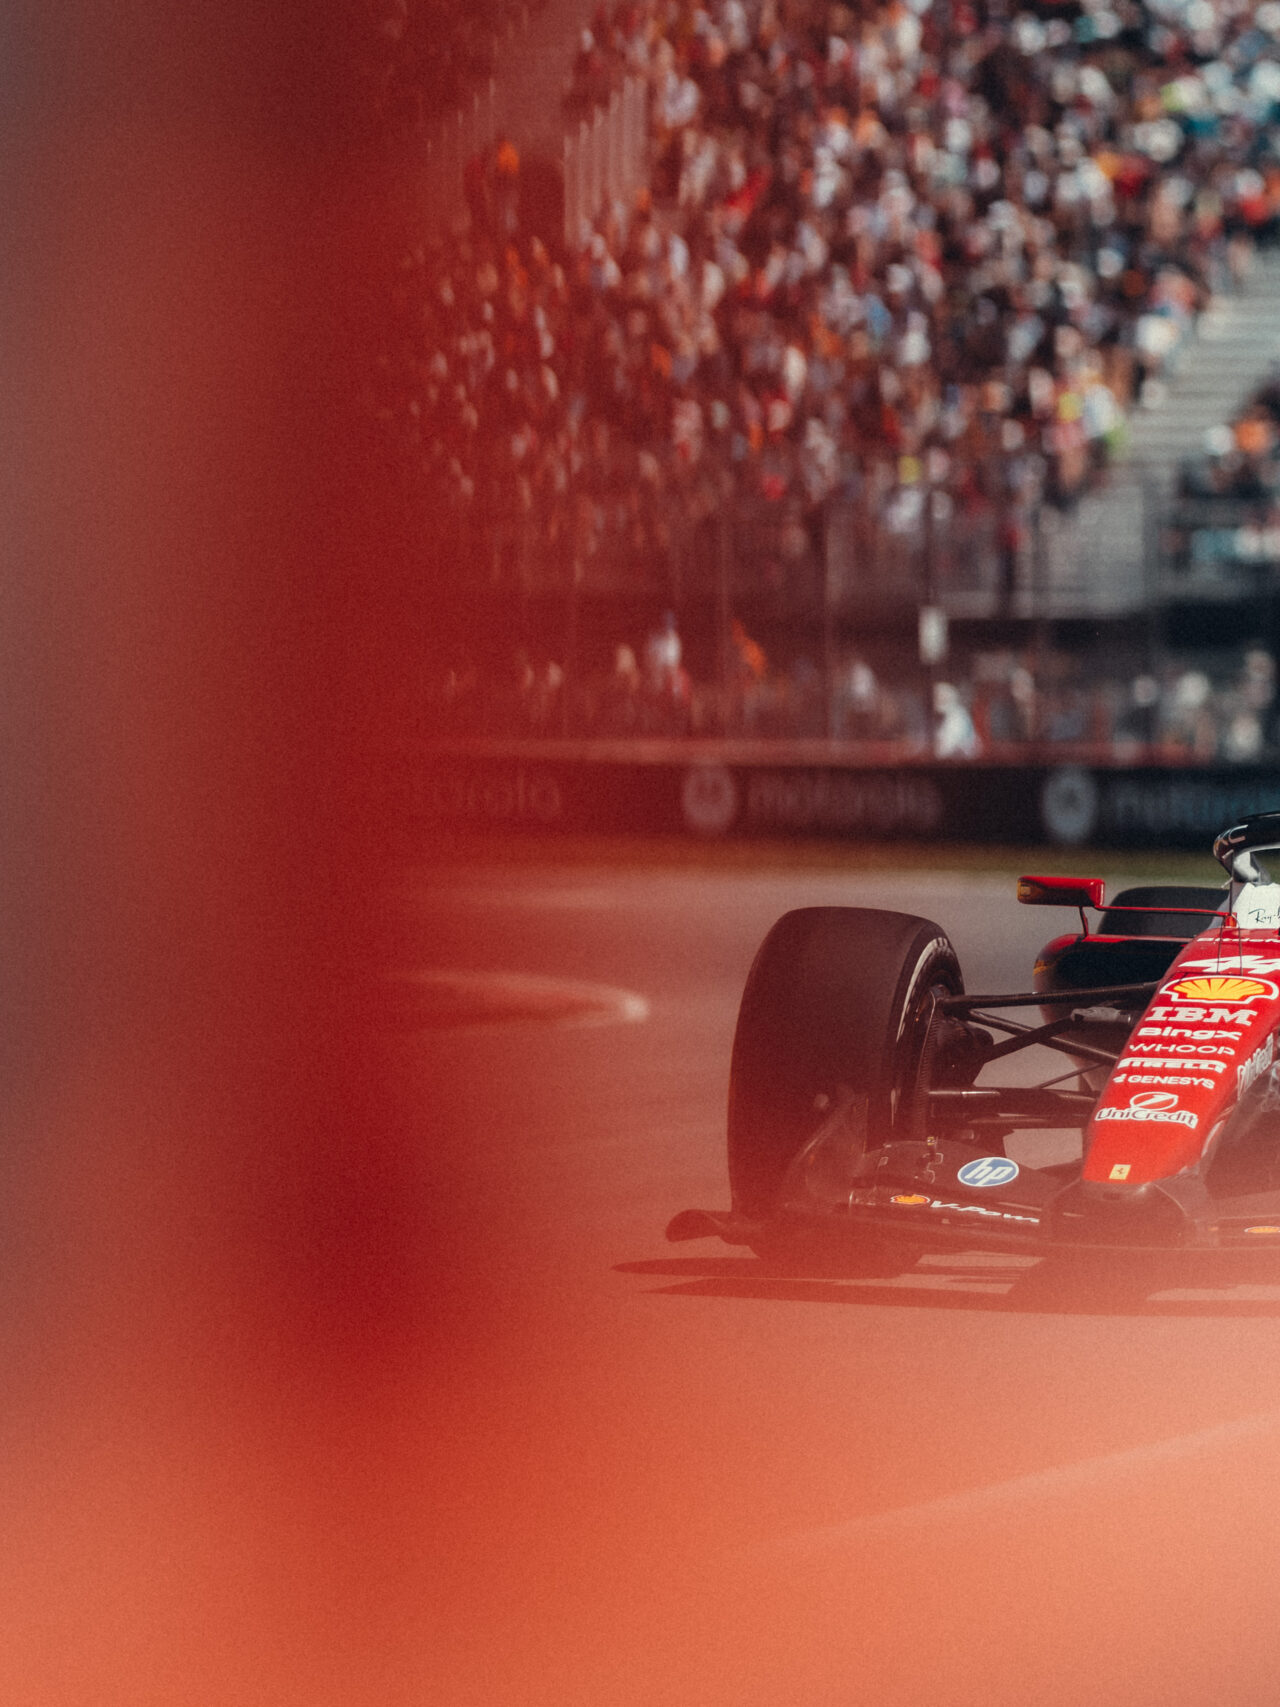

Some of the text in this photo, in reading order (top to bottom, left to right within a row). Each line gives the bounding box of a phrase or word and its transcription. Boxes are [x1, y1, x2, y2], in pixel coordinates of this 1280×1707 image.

[1145, 1007, 1258, 1026] IBM
[1129, 1043, 1235, 1056] WHOOP
[1117, 1057, 1227, 1074] PIRELLI
[1127, 1074, 1215, 1090] GENESYS
[1096, 1107, 1198, 1128] UniCredit
[963, 1157, 1014, 1186] hp
